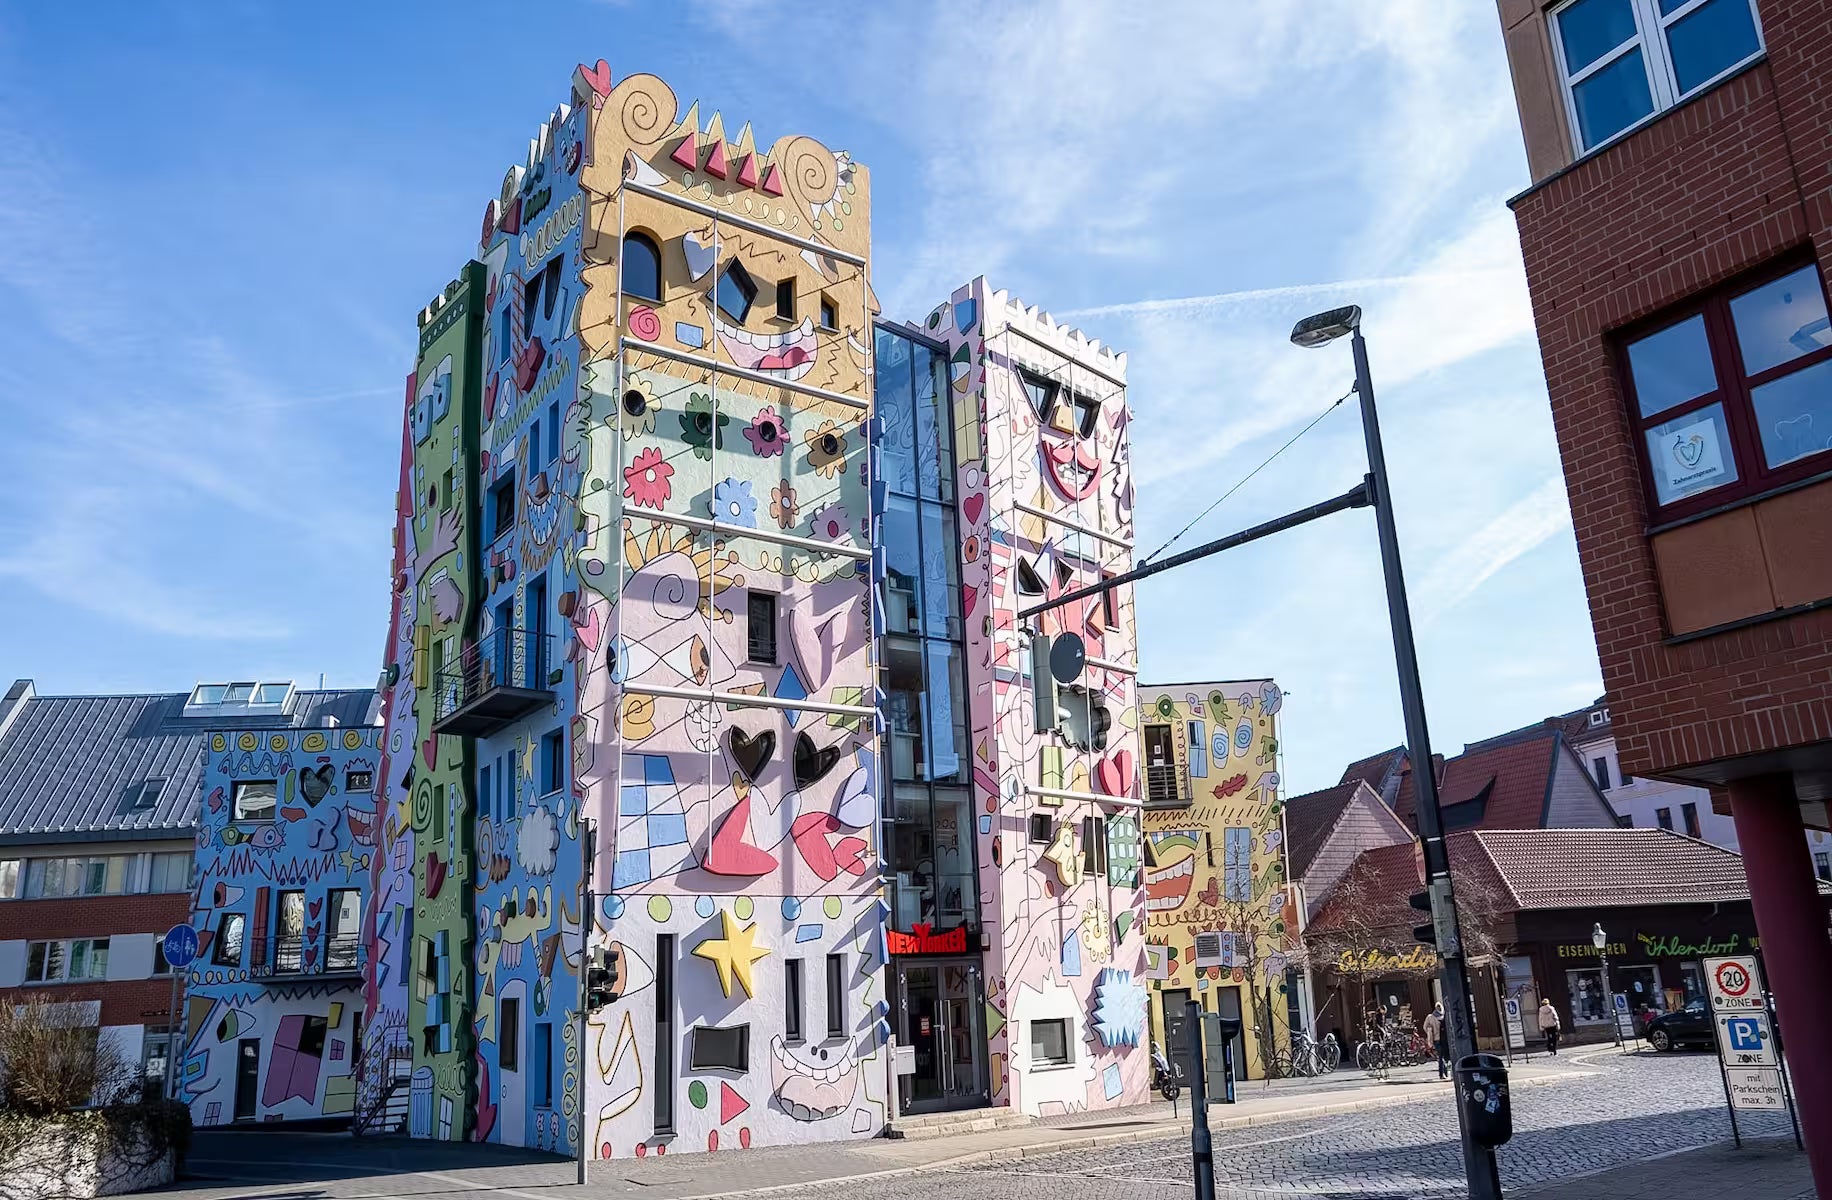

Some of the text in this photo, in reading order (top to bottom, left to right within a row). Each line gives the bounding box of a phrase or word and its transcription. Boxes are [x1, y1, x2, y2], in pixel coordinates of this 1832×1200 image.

[1557, 943, 1627, 957] EISENWREN
[1723, 970, 1744, 988] 20
[1725, 998, 1751, 1008] ZONE
[1734, 1022, 1751, 1047] P
[1737, 1054, 1763, 1064] ZNE
[1746, 1074, 1761, 1083] mit
[1732, 1084, 1781, 1095] Parkschein
[1741, 1096, 1777, 1105] max. 3h
